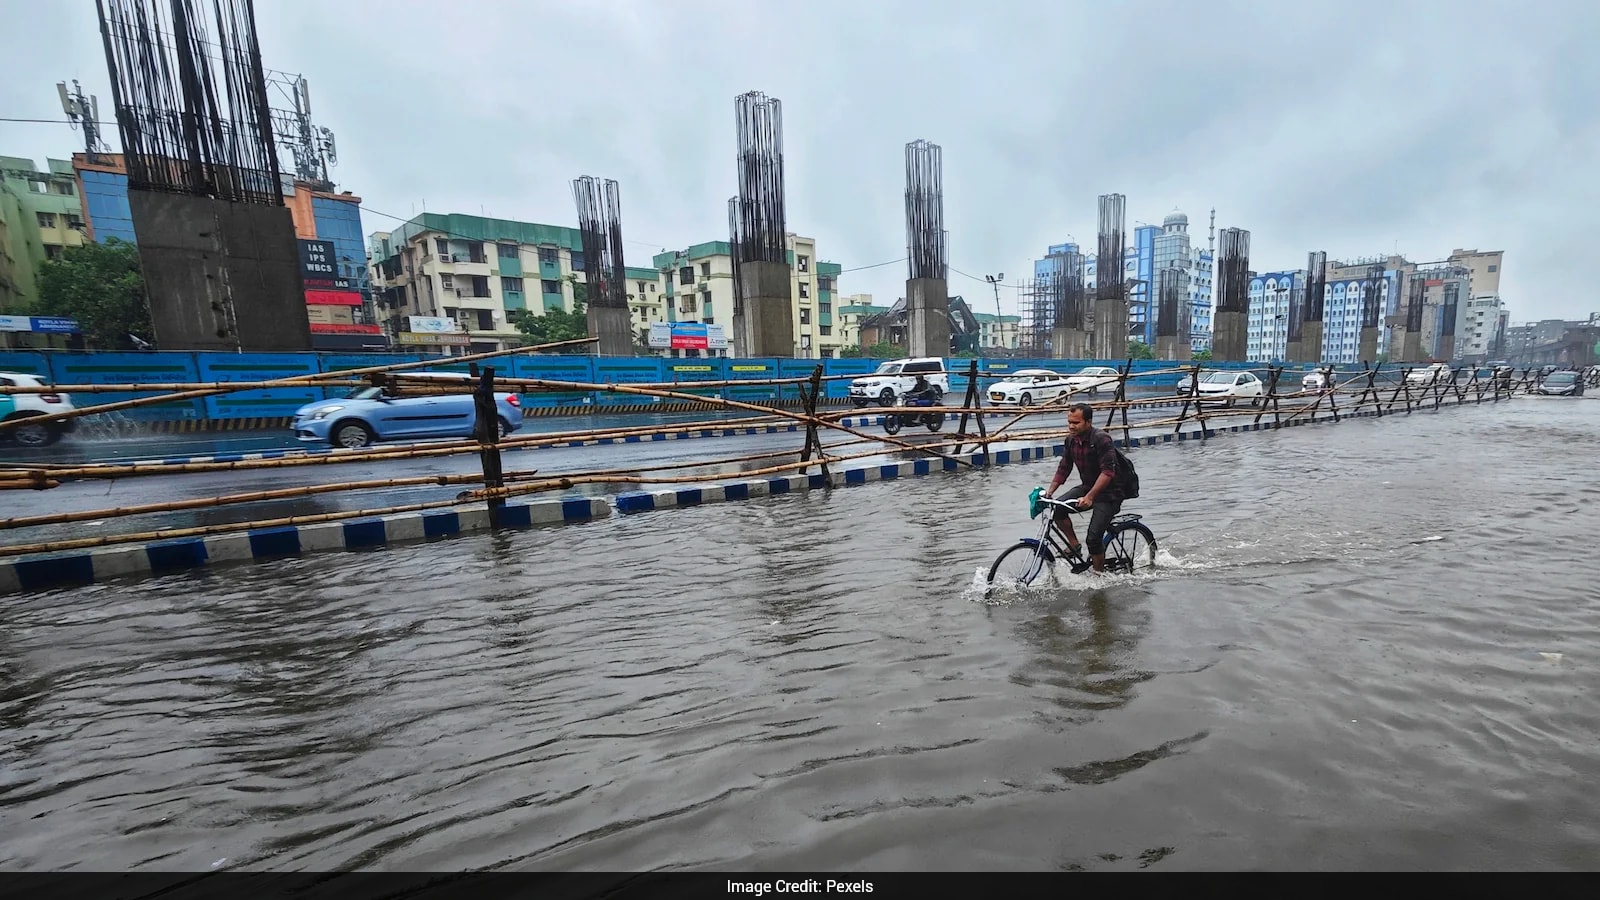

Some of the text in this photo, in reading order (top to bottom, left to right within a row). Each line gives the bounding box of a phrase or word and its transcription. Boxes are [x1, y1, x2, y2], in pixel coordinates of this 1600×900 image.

[307, 243, 325, 252] IAS
[309, 253, 326, 262] IPS
[306, 263, 333, 272] WBCS
[335, 280, 349, 288] IAS
